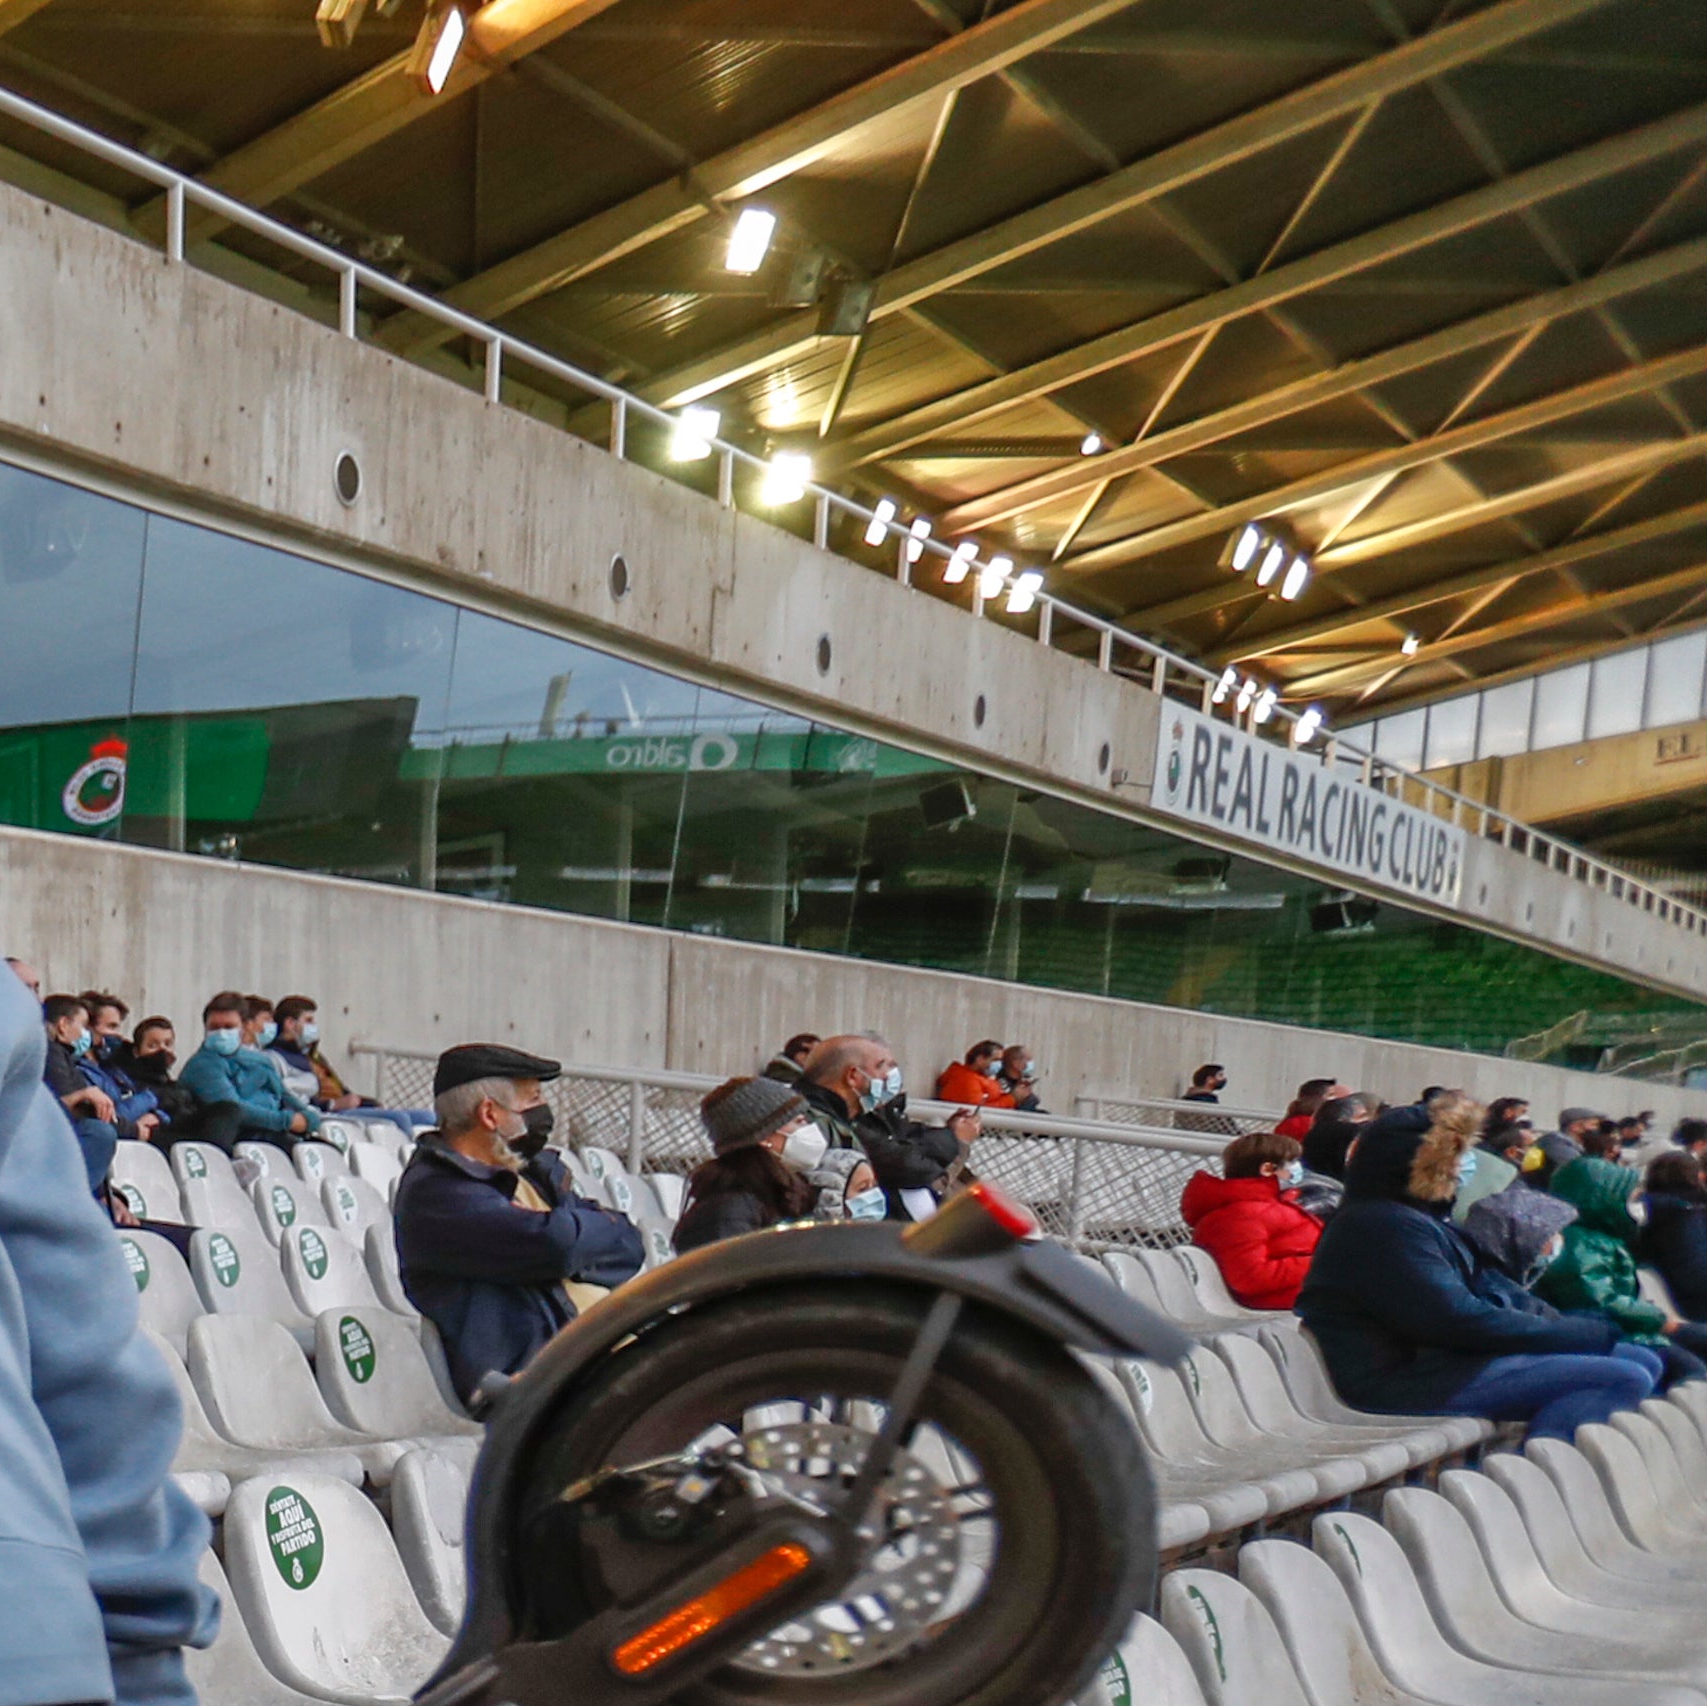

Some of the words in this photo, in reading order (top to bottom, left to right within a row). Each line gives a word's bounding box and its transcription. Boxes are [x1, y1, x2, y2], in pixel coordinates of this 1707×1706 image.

[1186, 723, 1270, 836] REAL
[1277, 761, 1388, 874] RACING
[1389, 811, 1448, 896] CLUB
[280, 1530, 316, 1557] PARTIDO
